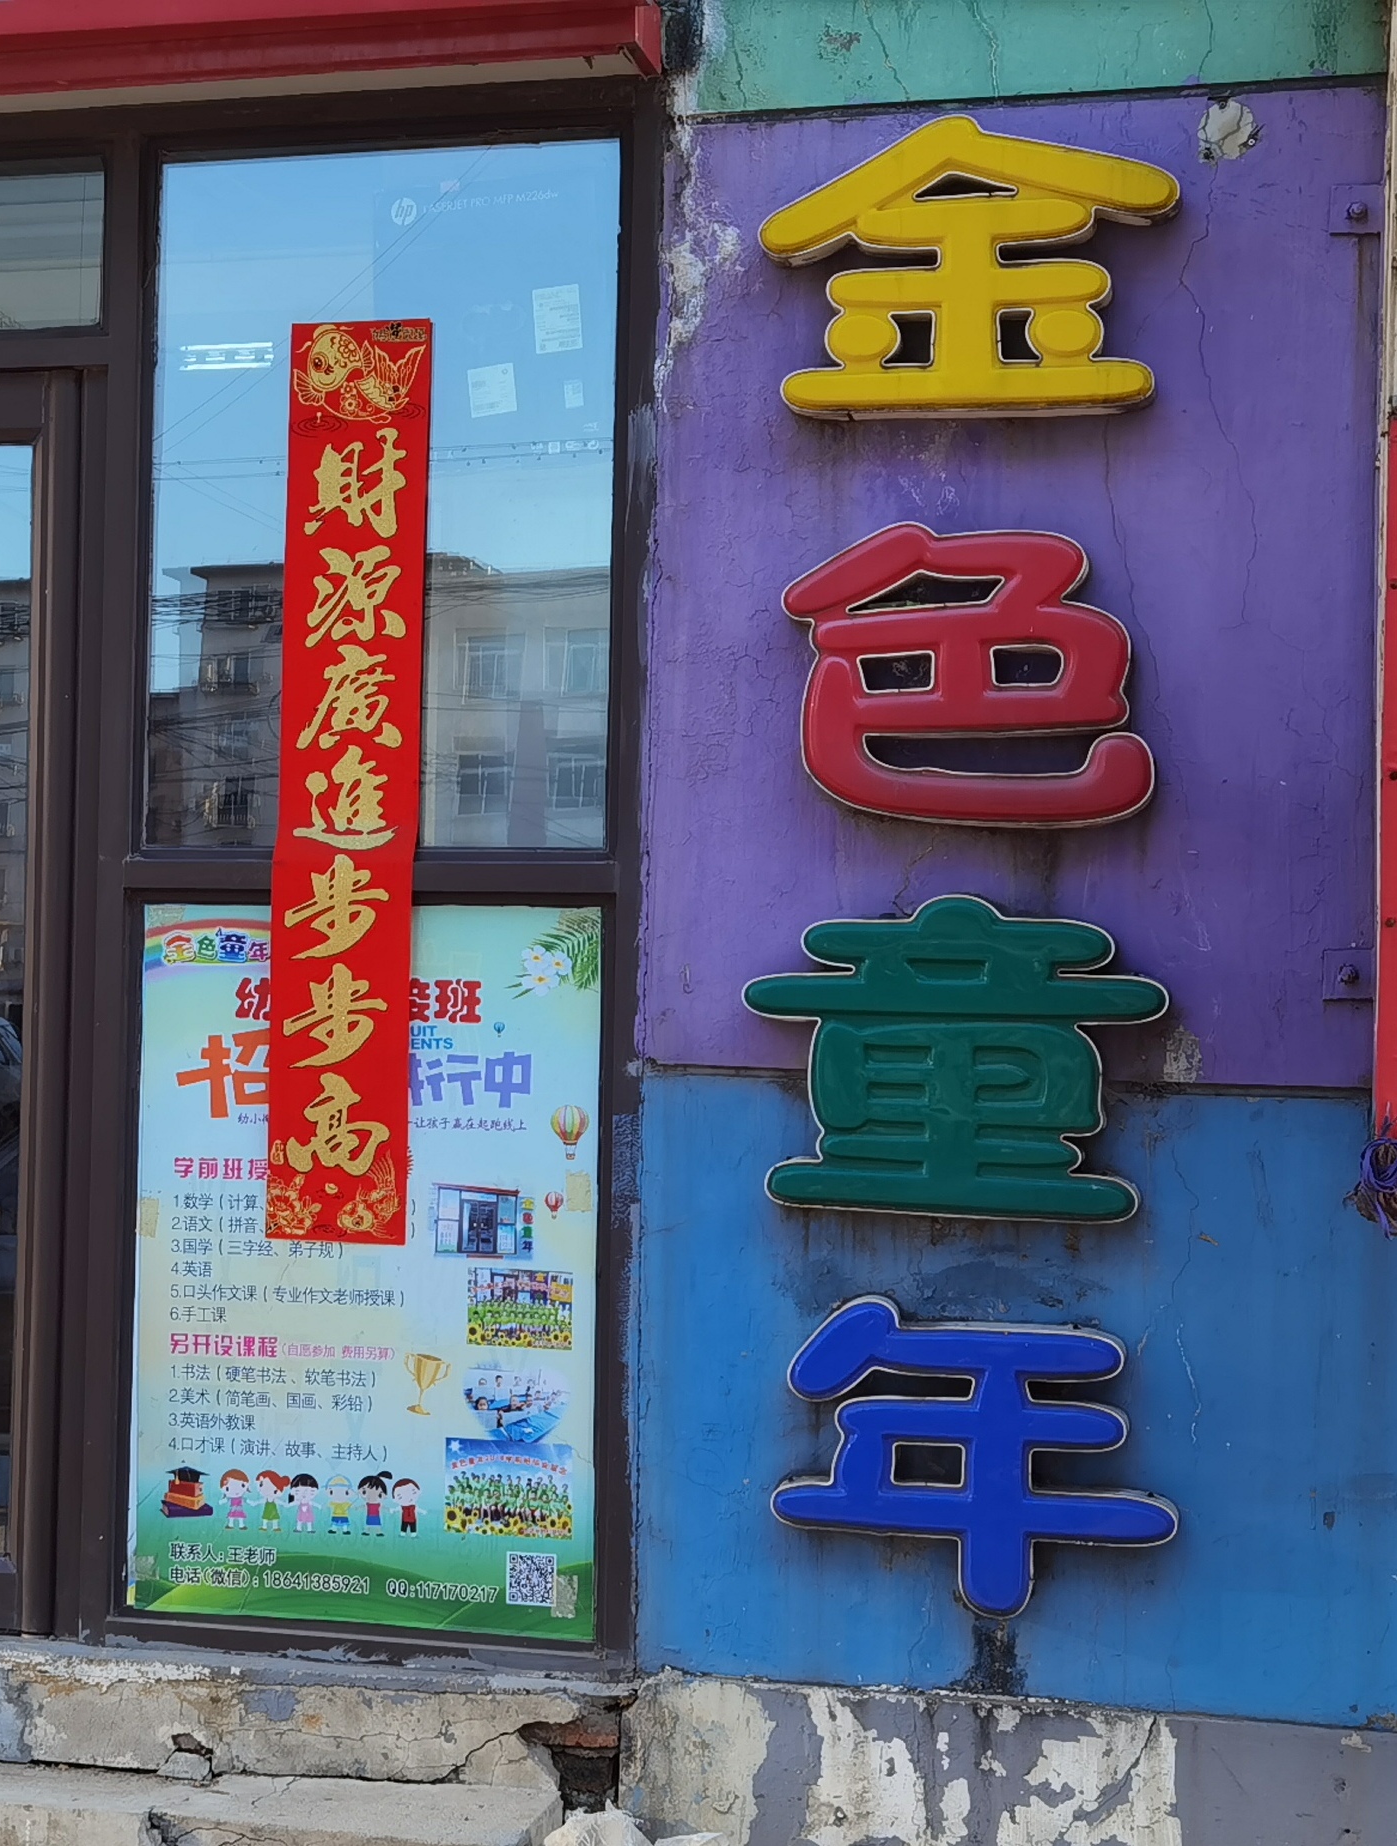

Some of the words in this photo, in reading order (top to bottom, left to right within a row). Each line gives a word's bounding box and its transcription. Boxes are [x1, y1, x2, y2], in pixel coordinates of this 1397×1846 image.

[391, 198, 417, 225] hp
[741, 113, 1183, 1619] 金色童年
[163, 931, 270, 964] 金色童年
[170, 1260, 213, 1278] 4.英语
[169, 1305, 227, 1324] 6.手工课
[169, 1332, 279, 1358] 另开设课程
[168, 1411, 256, 1431] 3.英语外教课
